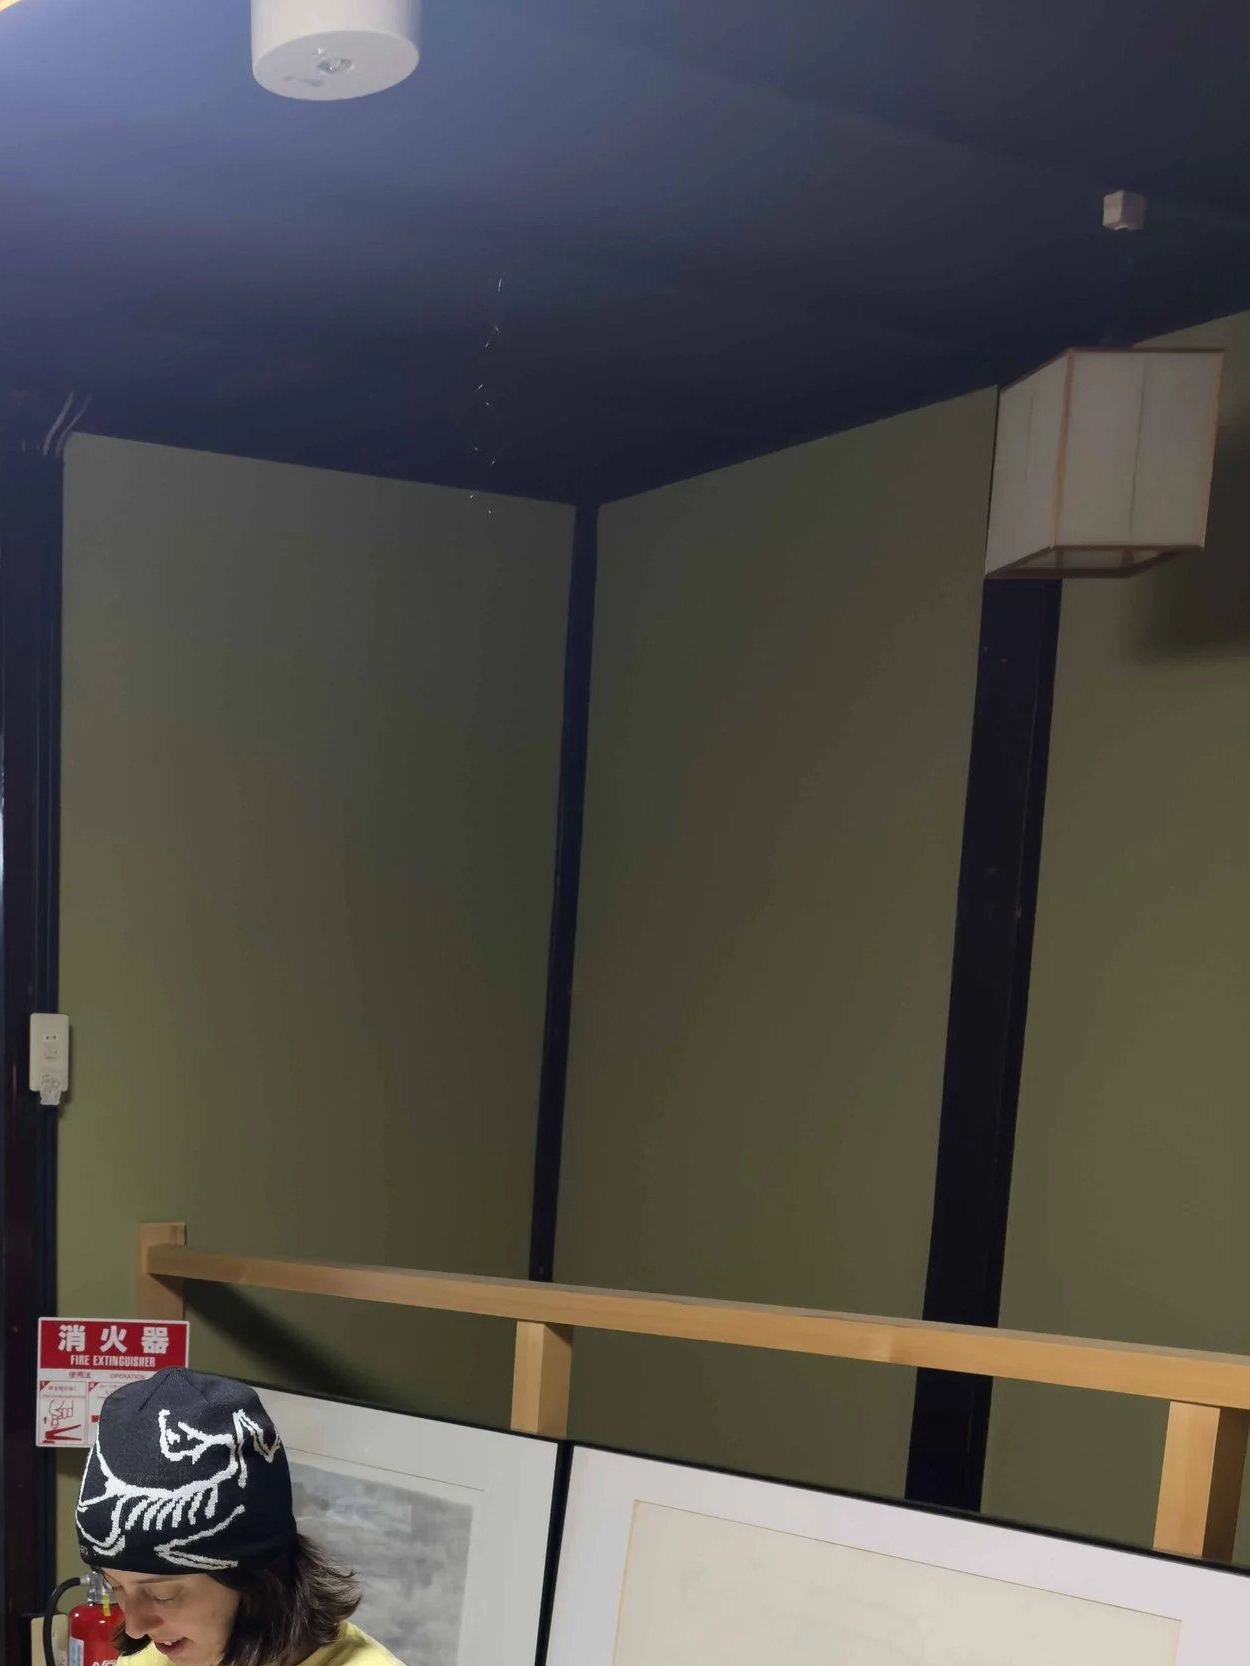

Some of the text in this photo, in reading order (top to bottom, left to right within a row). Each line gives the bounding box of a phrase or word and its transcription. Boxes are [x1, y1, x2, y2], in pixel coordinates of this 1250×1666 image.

[58, 1324, 169, 1354] 消火器
[70, 1354, 156, 1368] FIRE EXTINGUISHER
